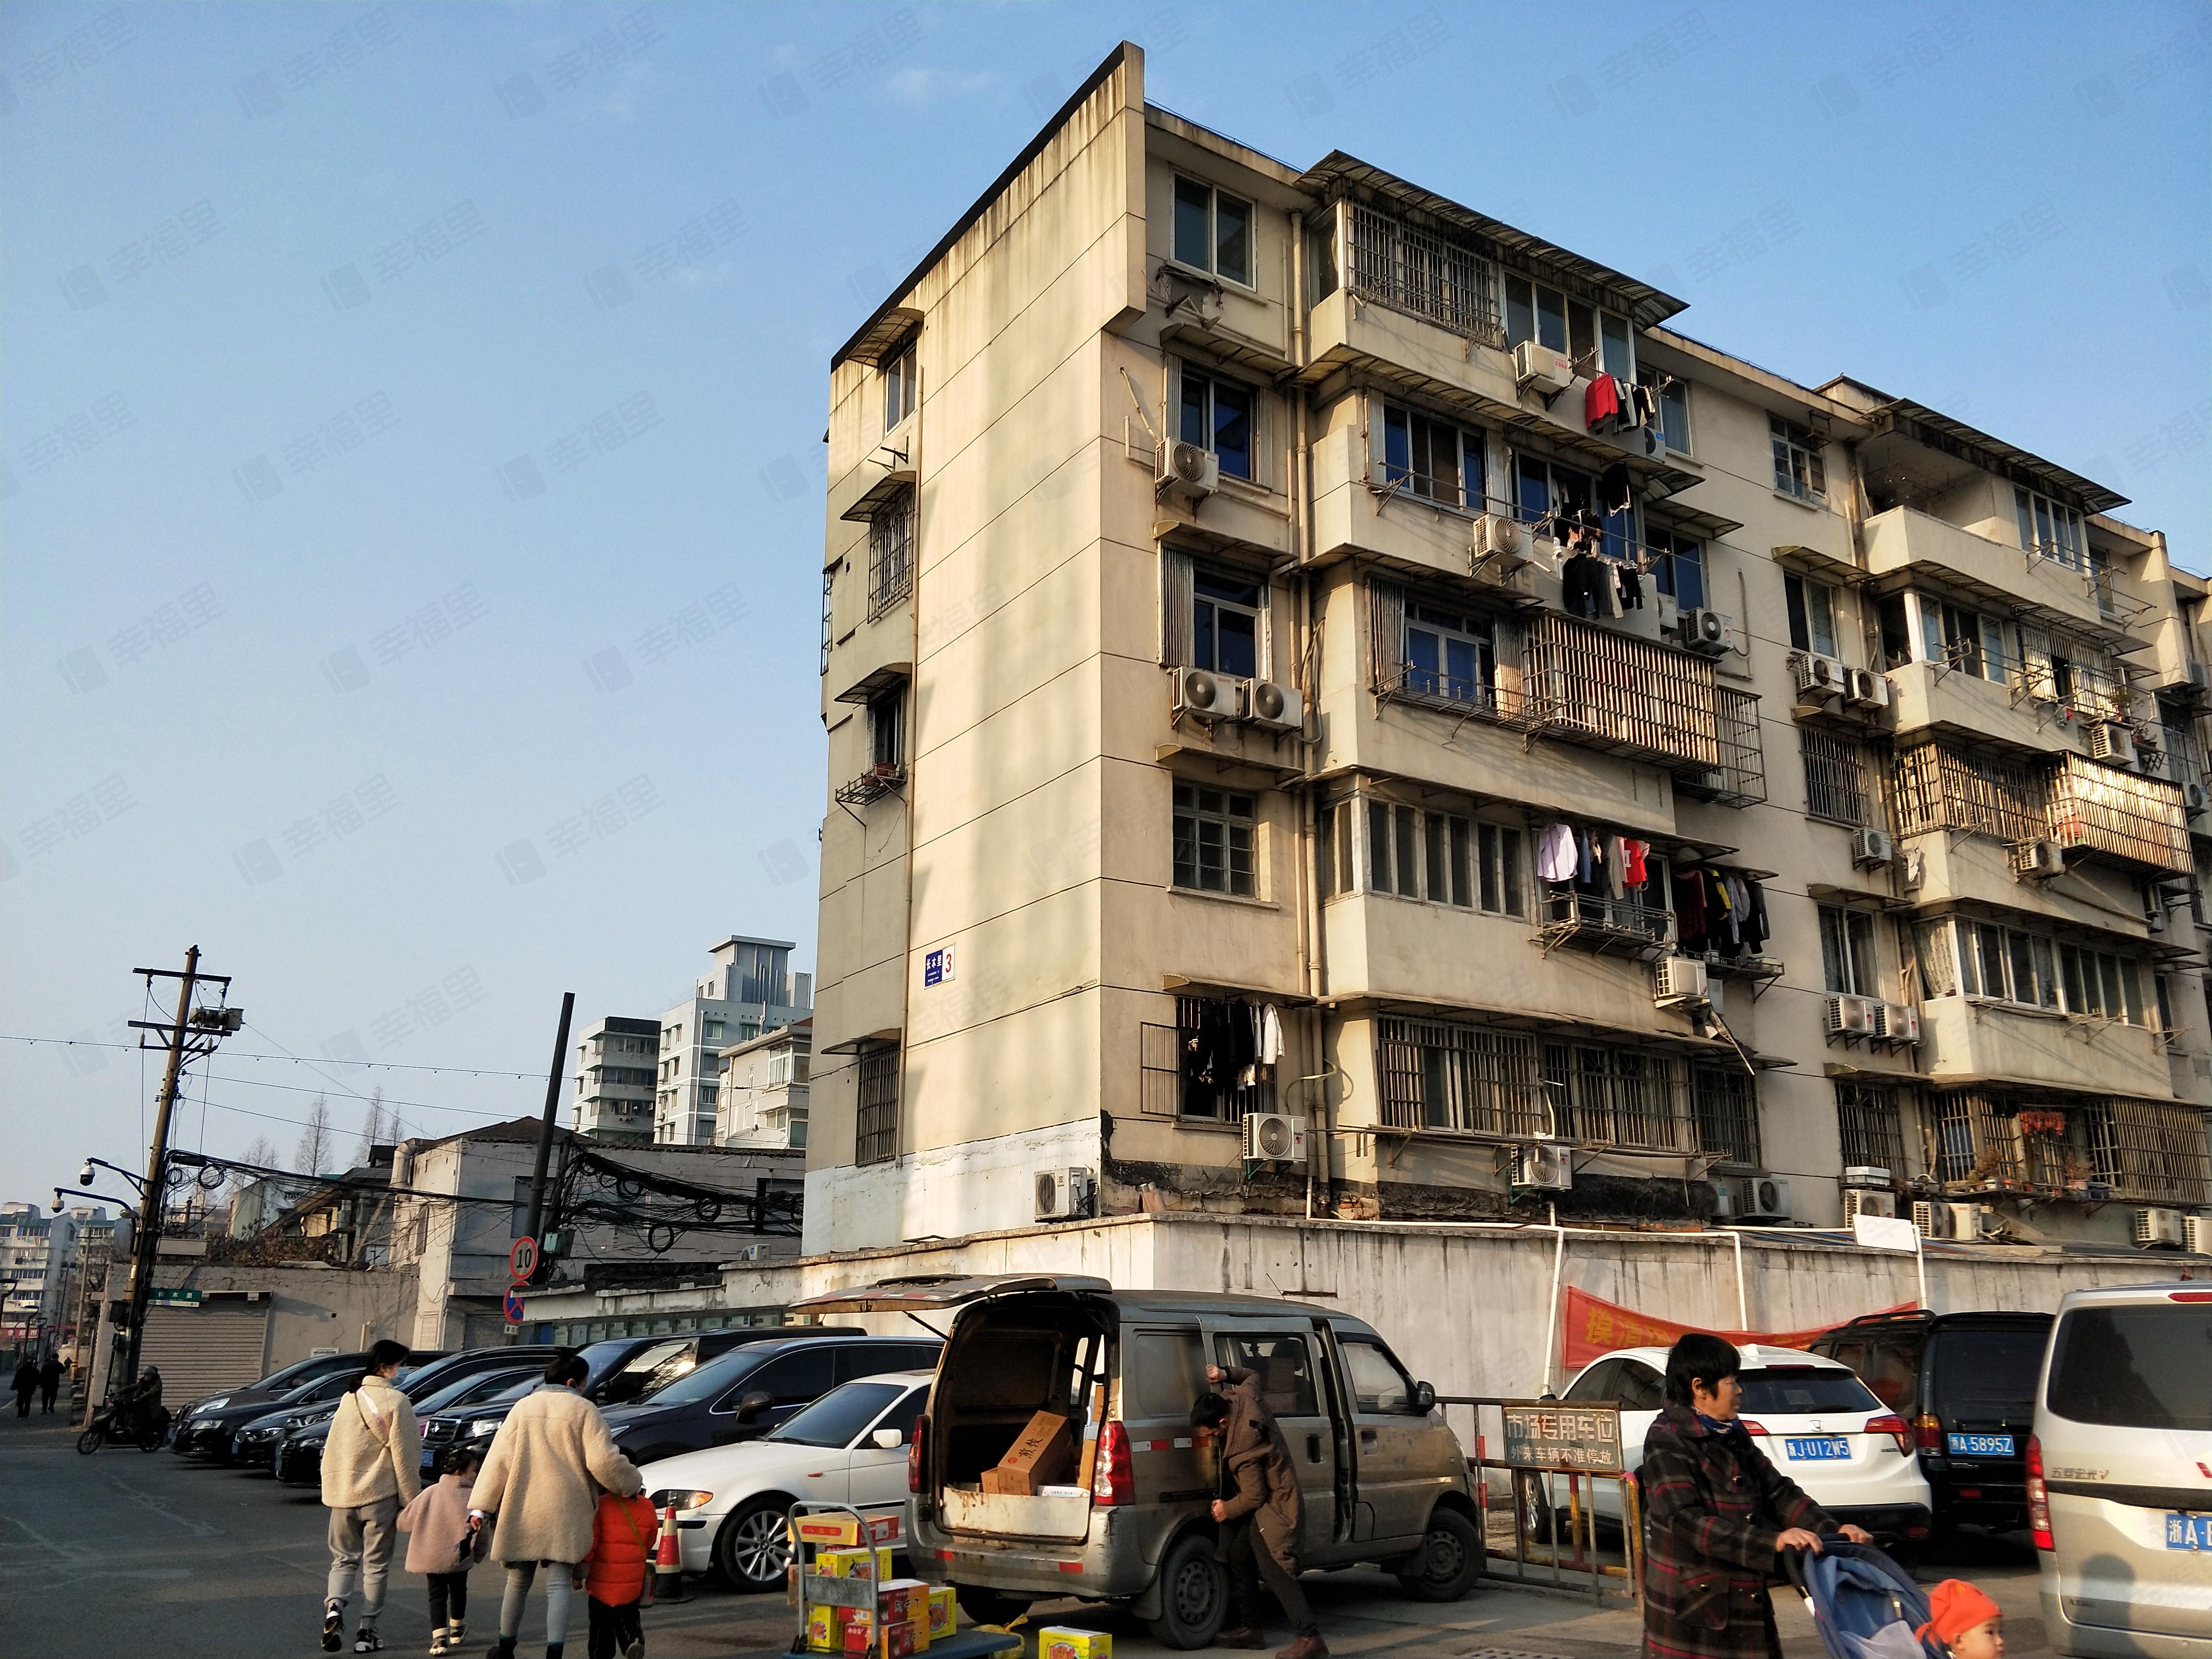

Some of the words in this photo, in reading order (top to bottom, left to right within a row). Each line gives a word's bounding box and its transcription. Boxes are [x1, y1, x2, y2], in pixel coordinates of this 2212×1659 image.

[926, 955, 942, 970] 长木里
[946, 953, 952, 973] 3
[517, 1248, 532, 1268] 10
[1506, 1413, 1613, 1443] 市场专用车位
[1511, 1445, 1613, 1465] 外来车辆不准停放
